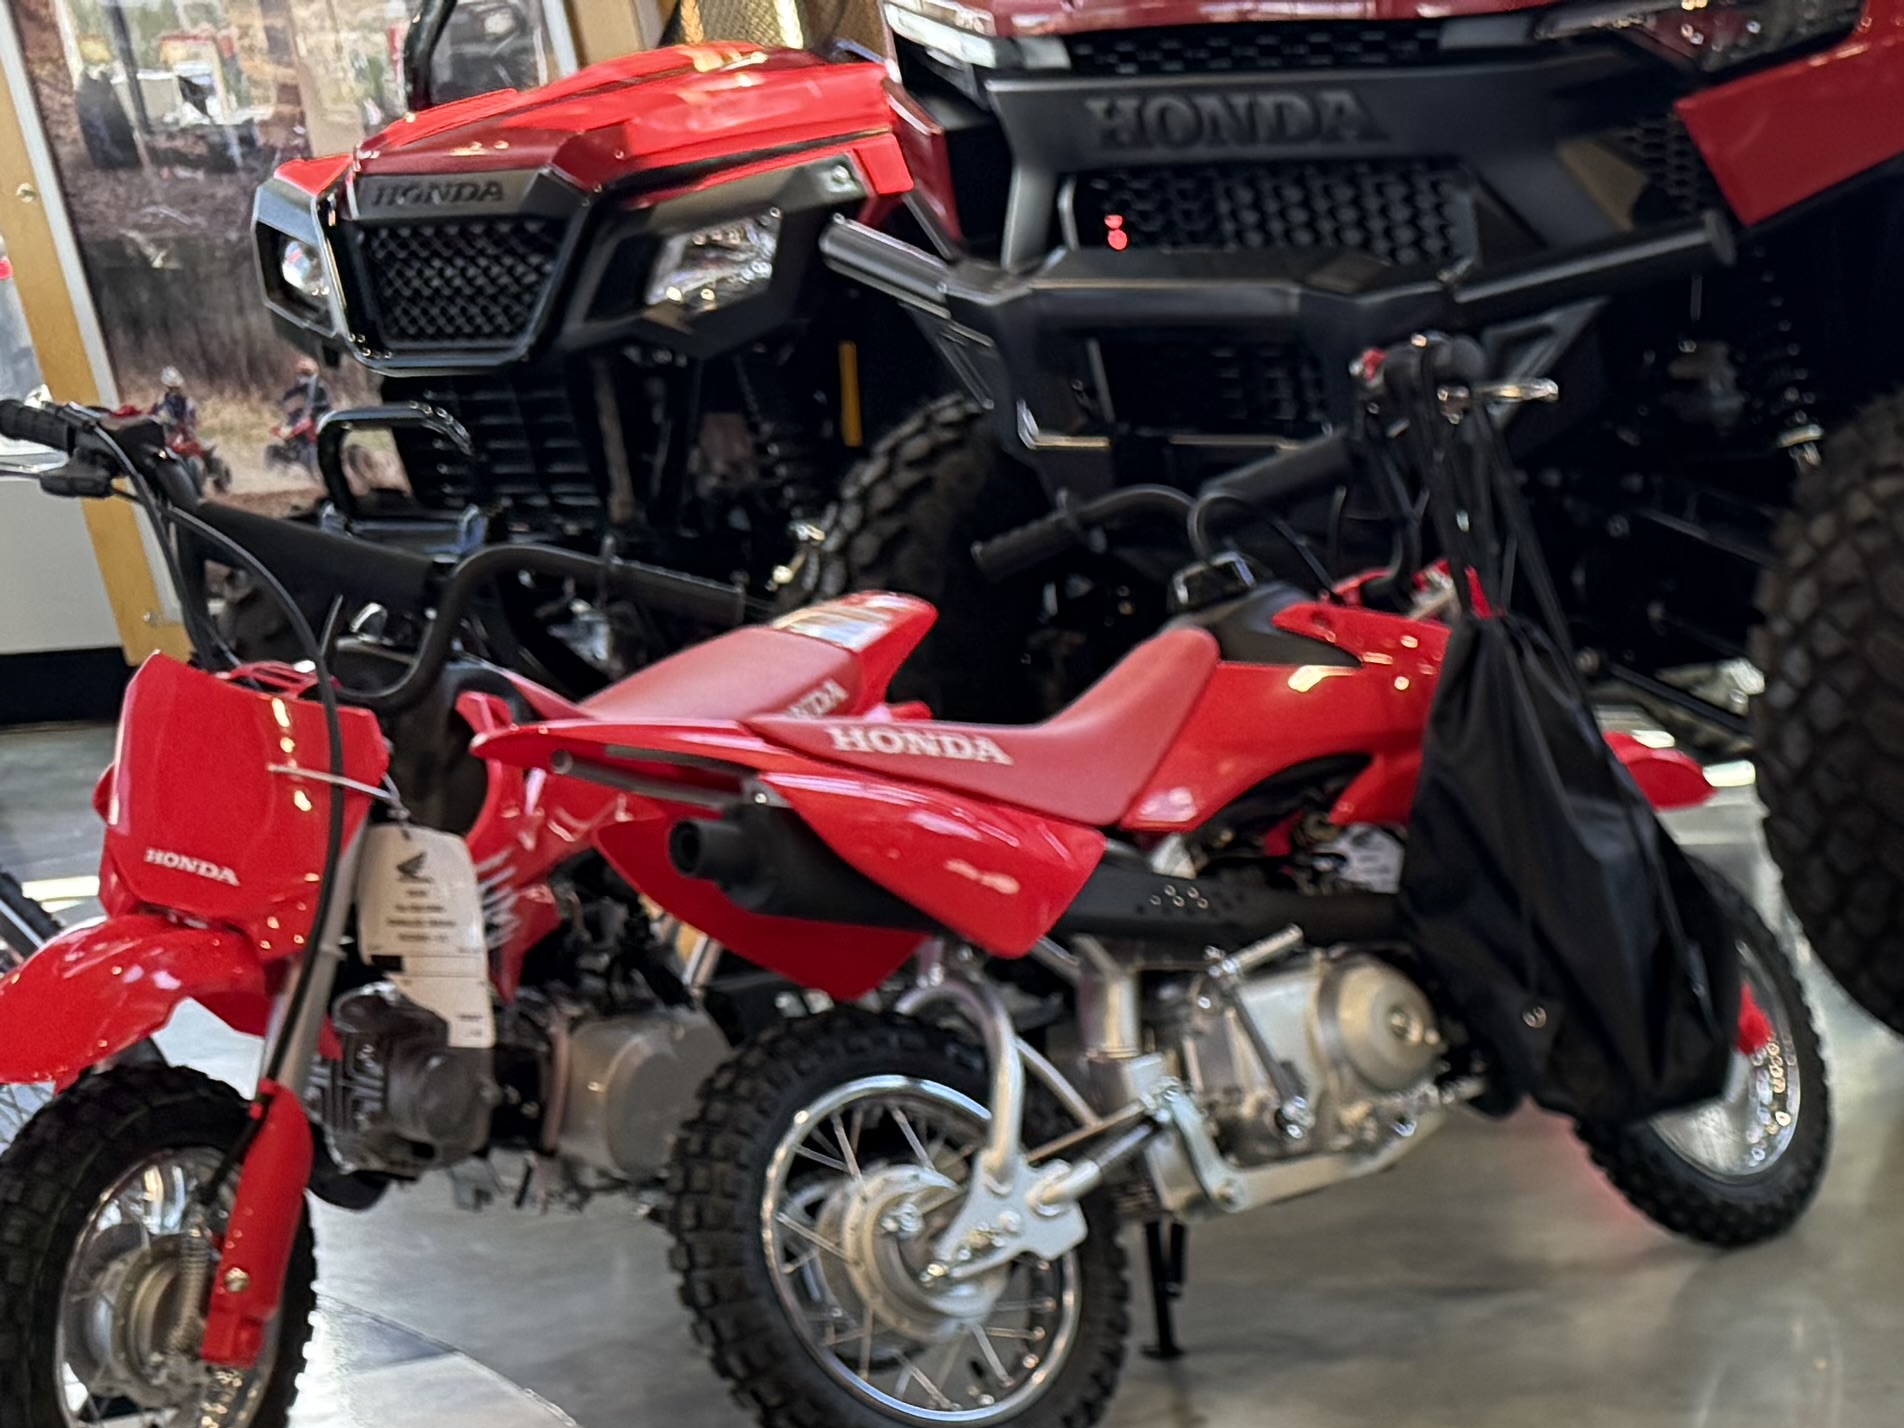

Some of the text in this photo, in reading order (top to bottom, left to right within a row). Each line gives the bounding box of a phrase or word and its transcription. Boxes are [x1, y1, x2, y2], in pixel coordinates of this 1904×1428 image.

[1085, 90, 1390, 148] HONDA
[373, 180, 504, 206] HONDA
[785, 678, 849, 717] NDA
[825, 726, 1014, 766] HONDA
[144, 847, 241, 887] HONDA
